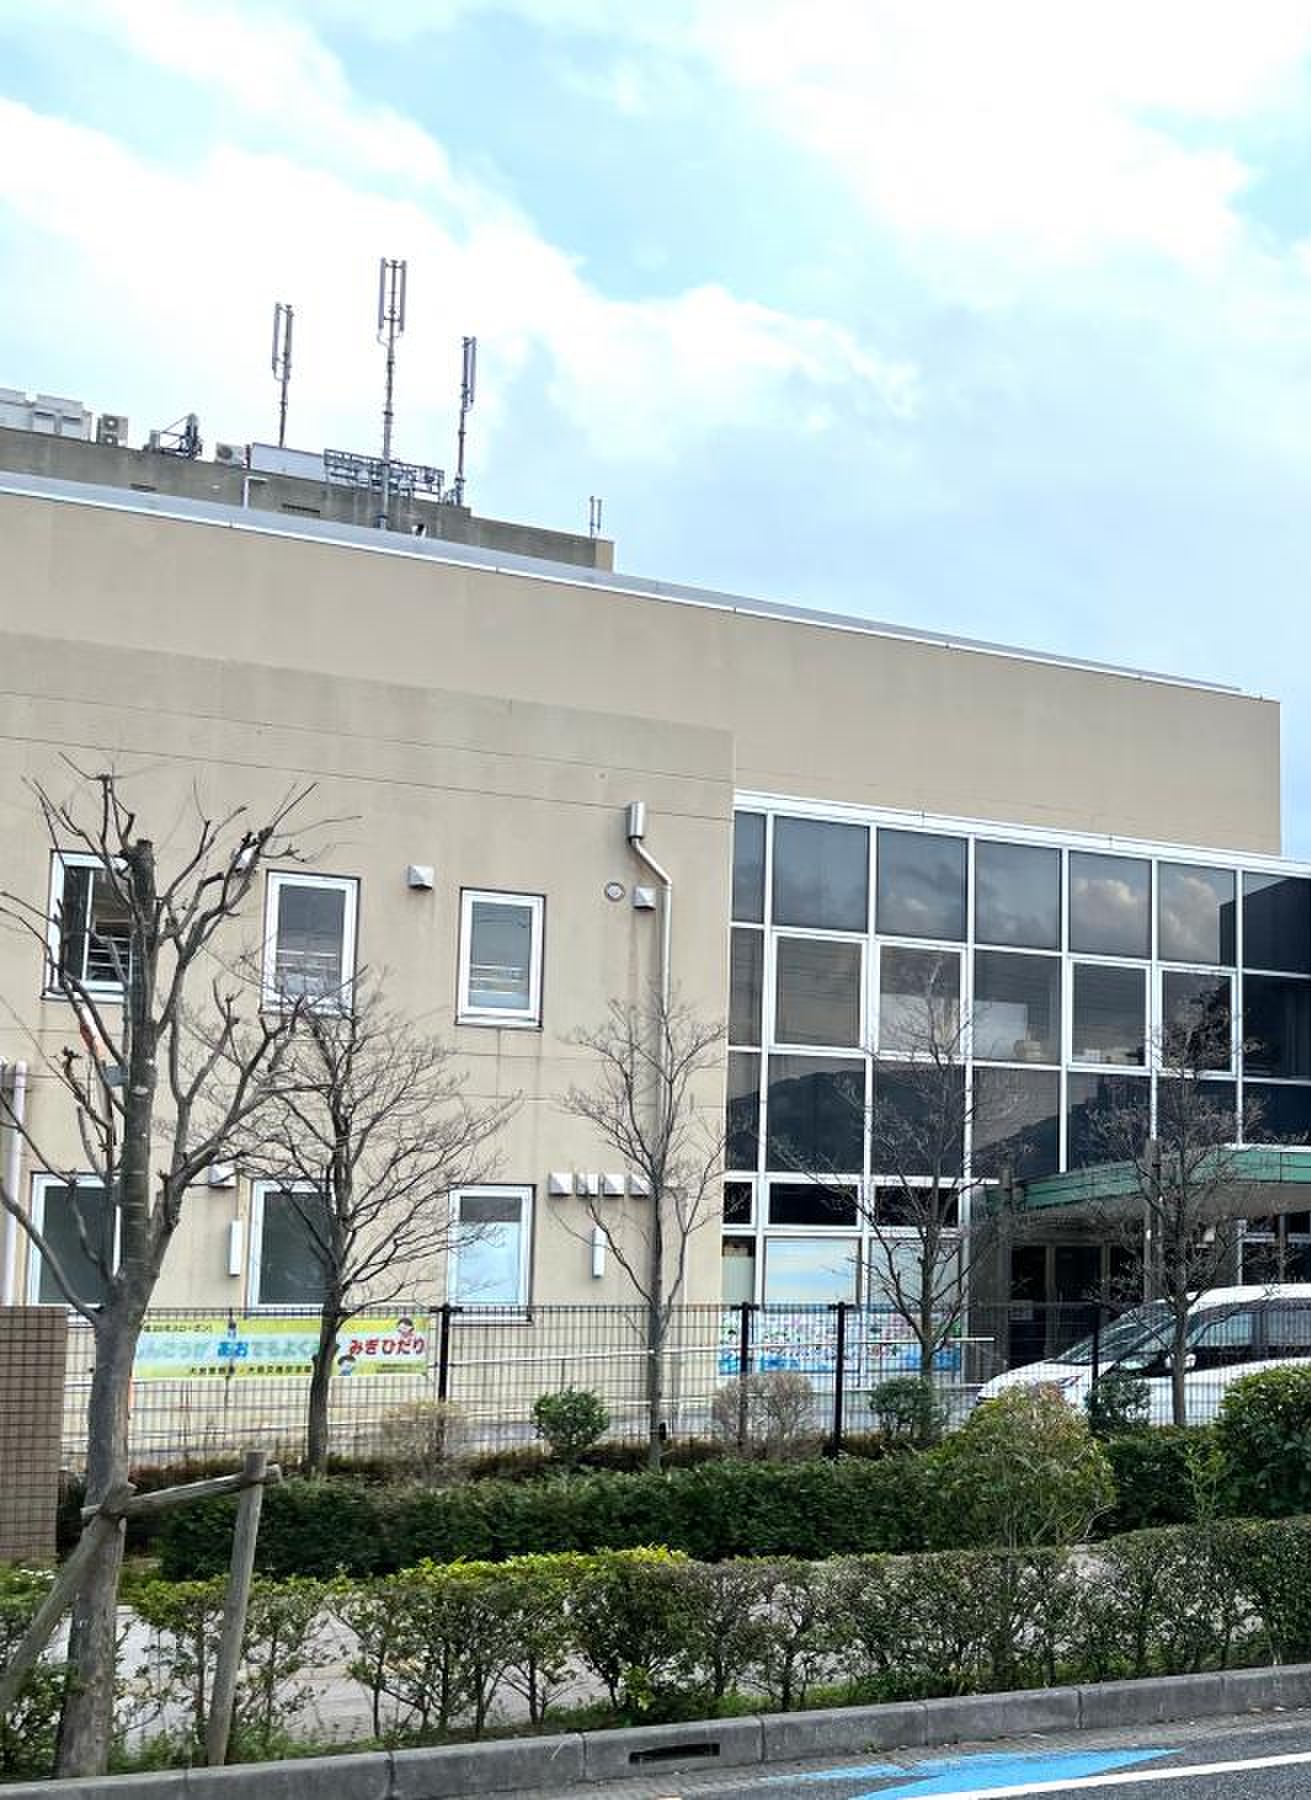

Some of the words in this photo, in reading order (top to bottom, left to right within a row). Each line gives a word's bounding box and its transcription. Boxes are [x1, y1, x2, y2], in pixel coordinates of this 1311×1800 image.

[350, 1338, 425, 1356] みぎひだり
